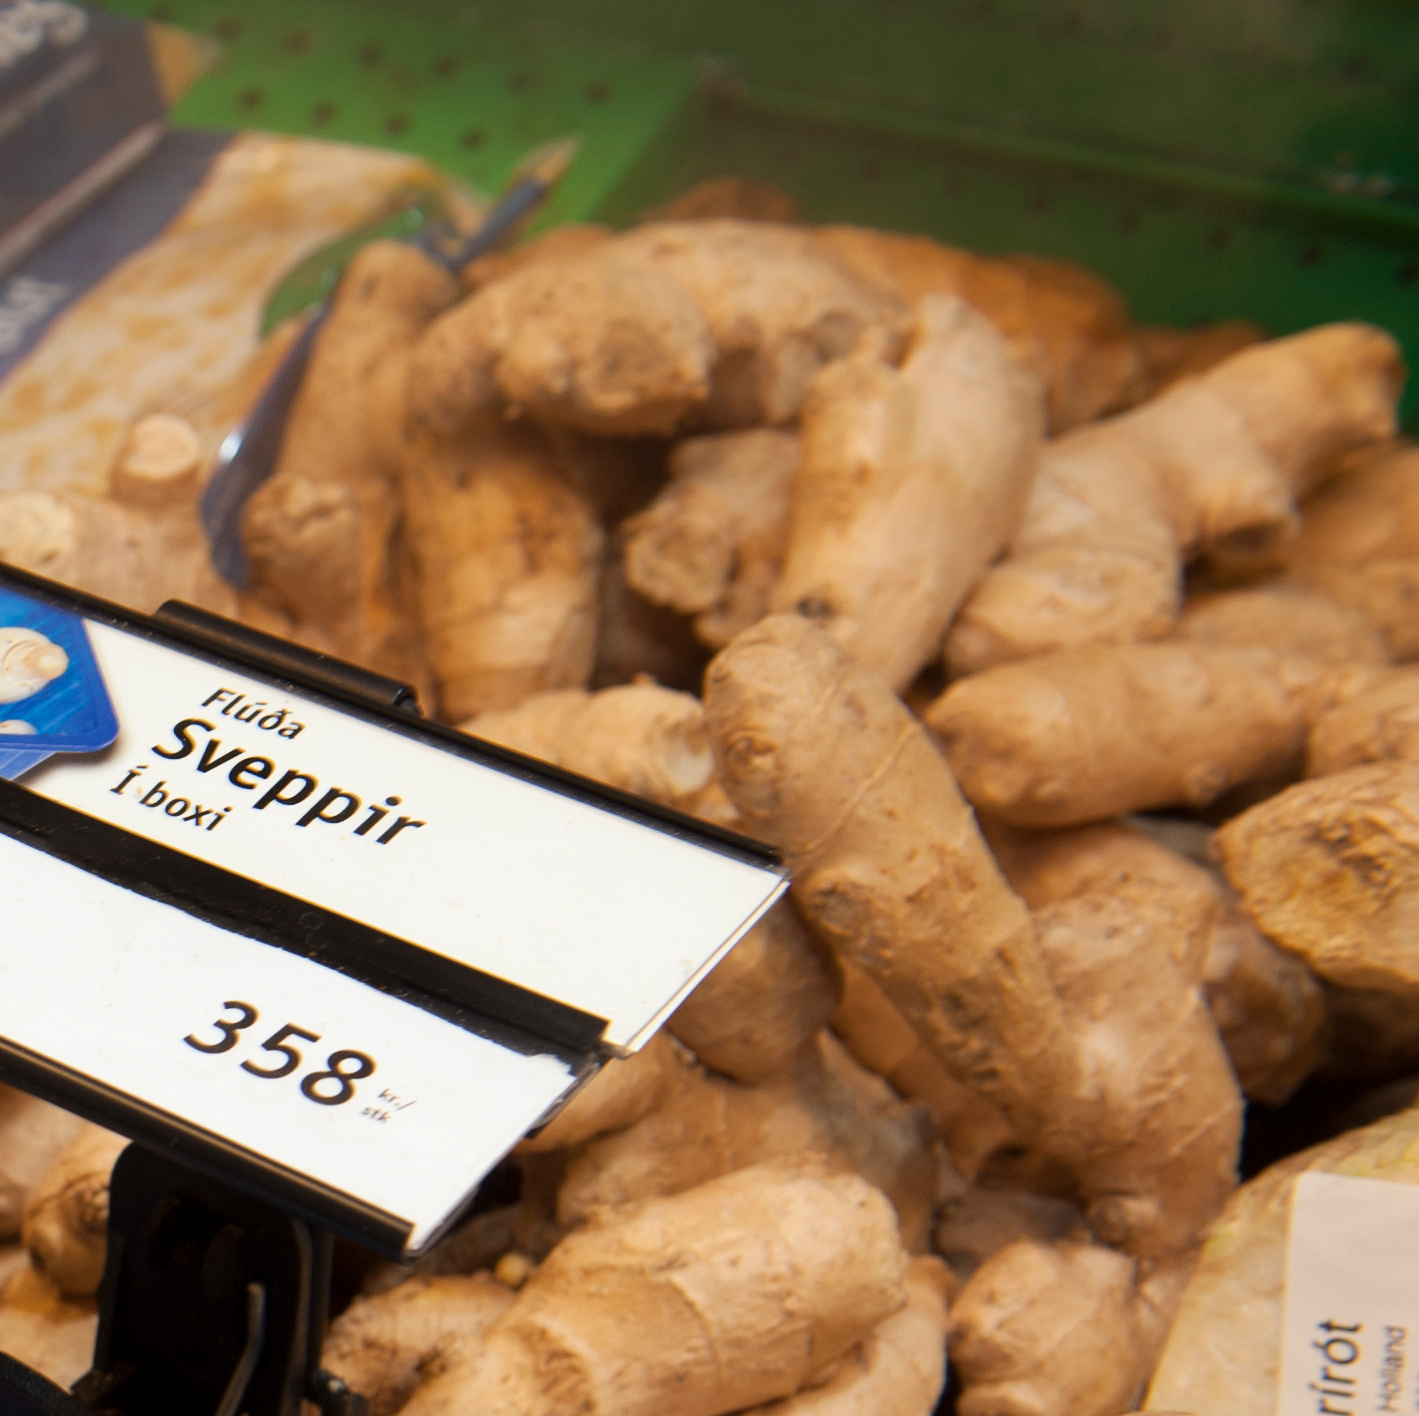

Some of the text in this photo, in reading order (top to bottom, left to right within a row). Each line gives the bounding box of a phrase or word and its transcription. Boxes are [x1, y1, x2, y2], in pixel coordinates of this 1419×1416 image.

[200, 686, 305, 740] Flúða
[139, 780, 233, 832] boxi
[150, 716, 427, 845] Sveppir
[183, 1000, 377, 1106] 358
[361, 1107, 391, 1123] stk
[1376, 1326, 1408, 1412] Holland
